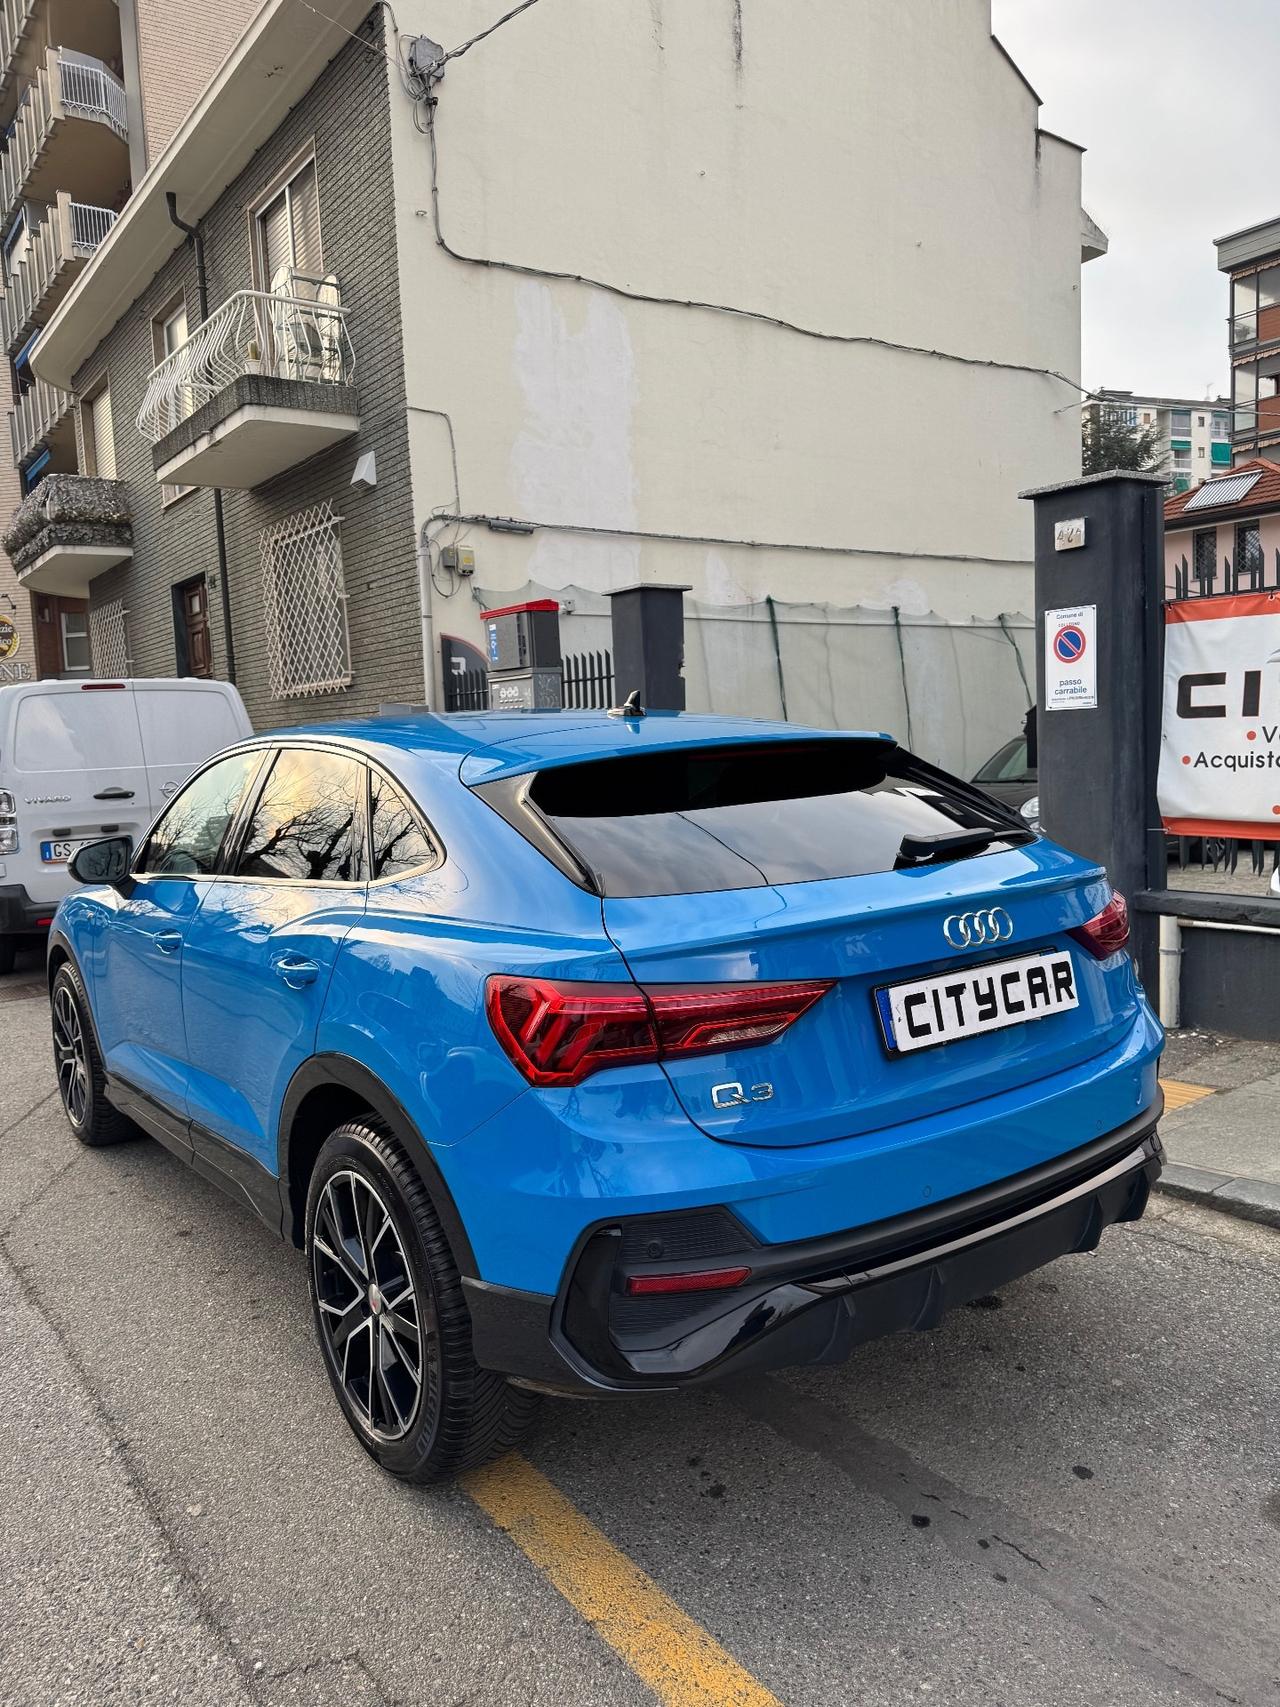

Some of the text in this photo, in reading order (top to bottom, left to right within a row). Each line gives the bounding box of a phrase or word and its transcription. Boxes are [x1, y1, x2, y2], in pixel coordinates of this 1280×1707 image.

[1059, 678, 1082, 687] passo
[1055, 686, 1088, 695] carrabile
[1262, 725, 1280, 744] V
[24, 795, 72, 804] VIVARO
[904, 960, 1076, 1039] CITYCAR
[711, 1082, 774, 1109] Q3
